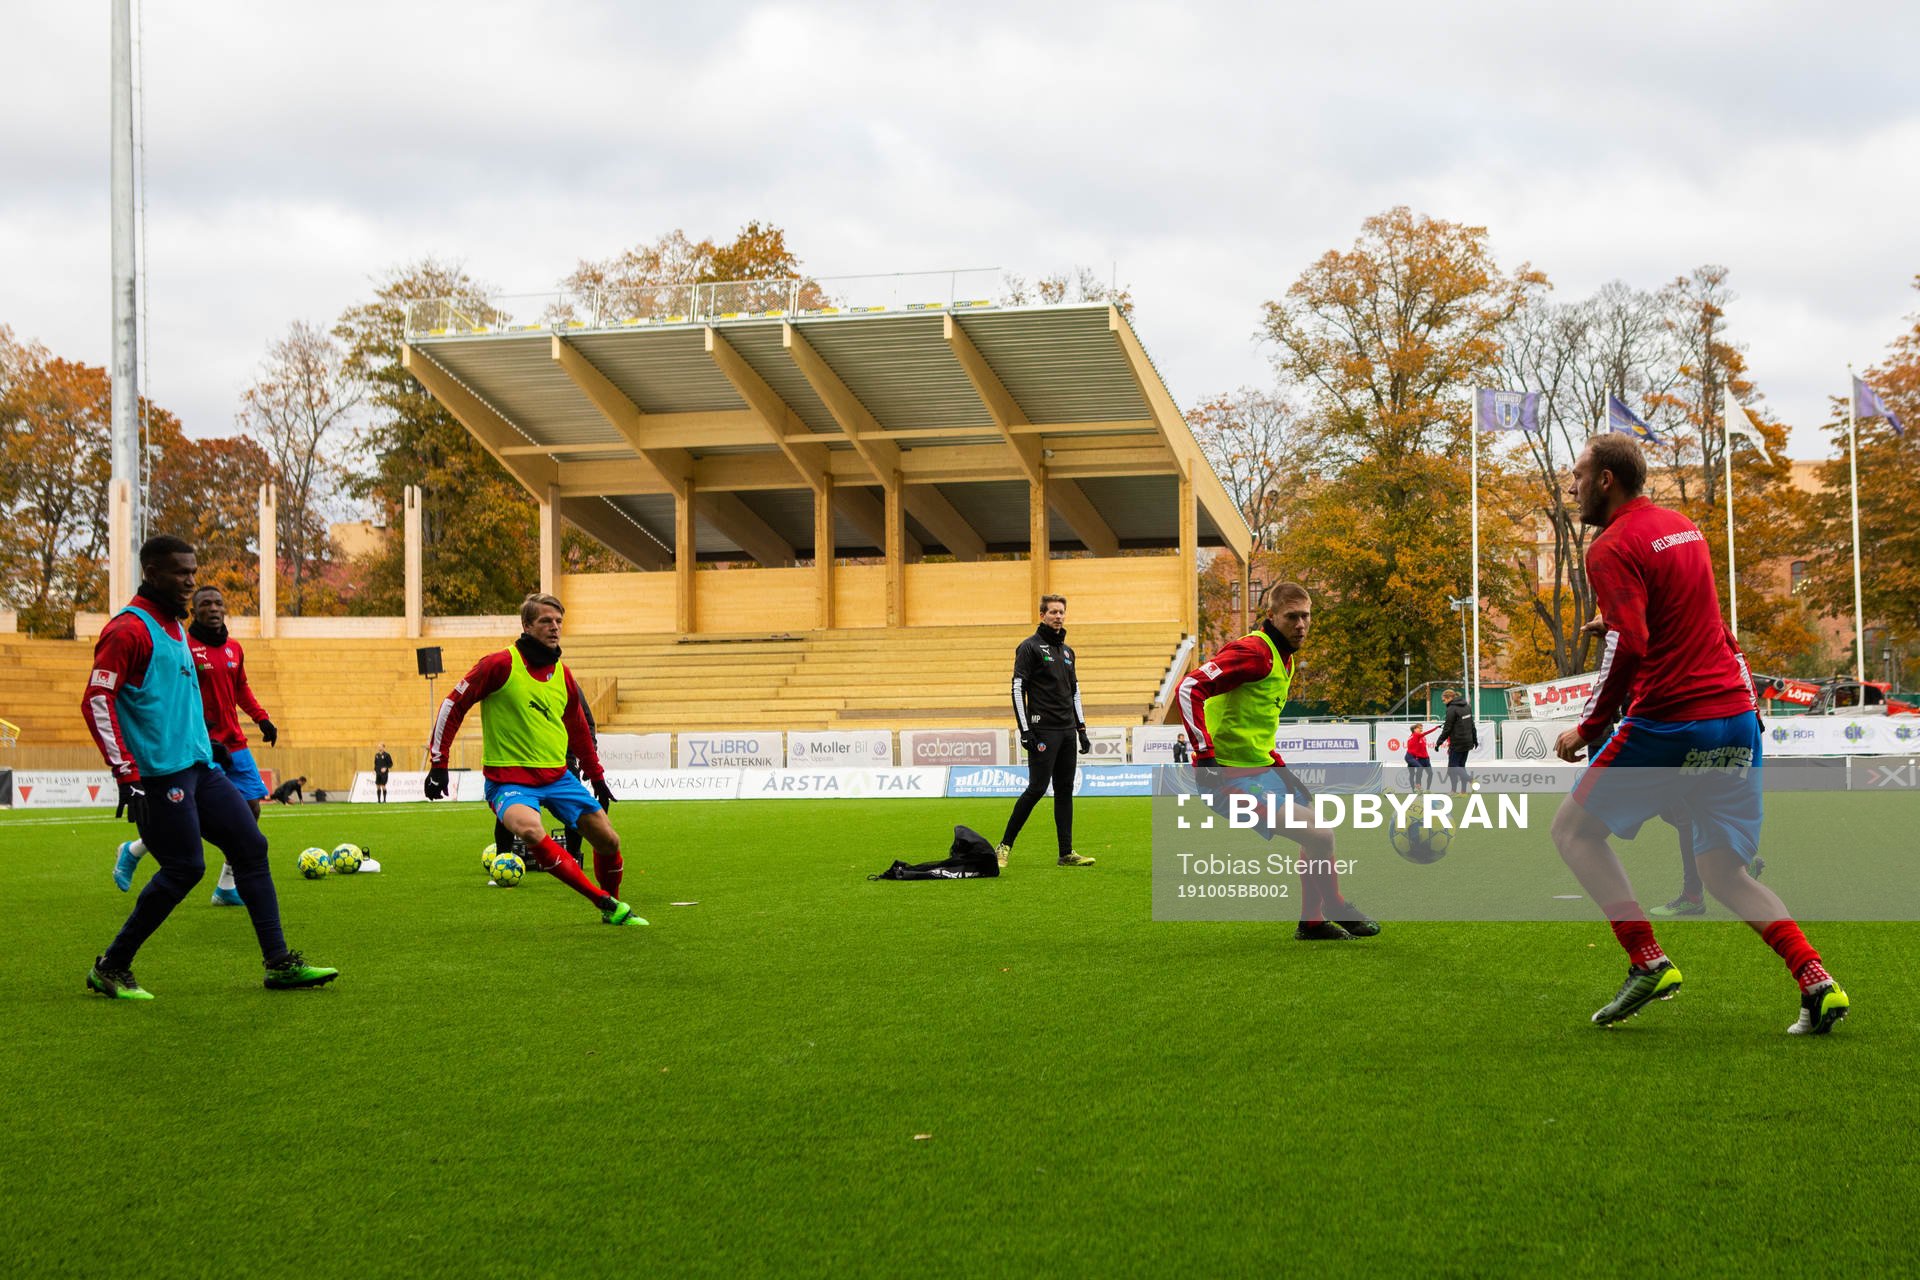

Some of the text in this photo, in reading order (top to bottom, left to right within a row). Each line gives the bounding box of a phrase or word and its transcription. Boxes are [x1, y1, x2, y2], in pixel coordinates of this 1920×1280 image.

[1651, 530, 1699, 552] HELSINGBORGS
[1031, 715, 1041, 723] MP
[1772, 729, 1788, 740] GK
[1845, 726, 1863, 739] GK
[1896, 728, 1912, 738] GK
[855, 741, 868, 753] Bil
[917, 738, 992, 758] colorama
[1306, 740, 1355, 749] CENTRALEN
[599, 751, 665, 762] Making Future
[1685, 746, 1754, 761] ÖRESUNDS
[1679, 757, 1752, 779] KRAFT
[643, 776, 733, 790] UNIVERSITET
[762, 772, 923, 791] ÅRSTA TAK
[1290, 767, 1326, 785] SKAN
[1437, 770, 1556, 787] Vkswagen
